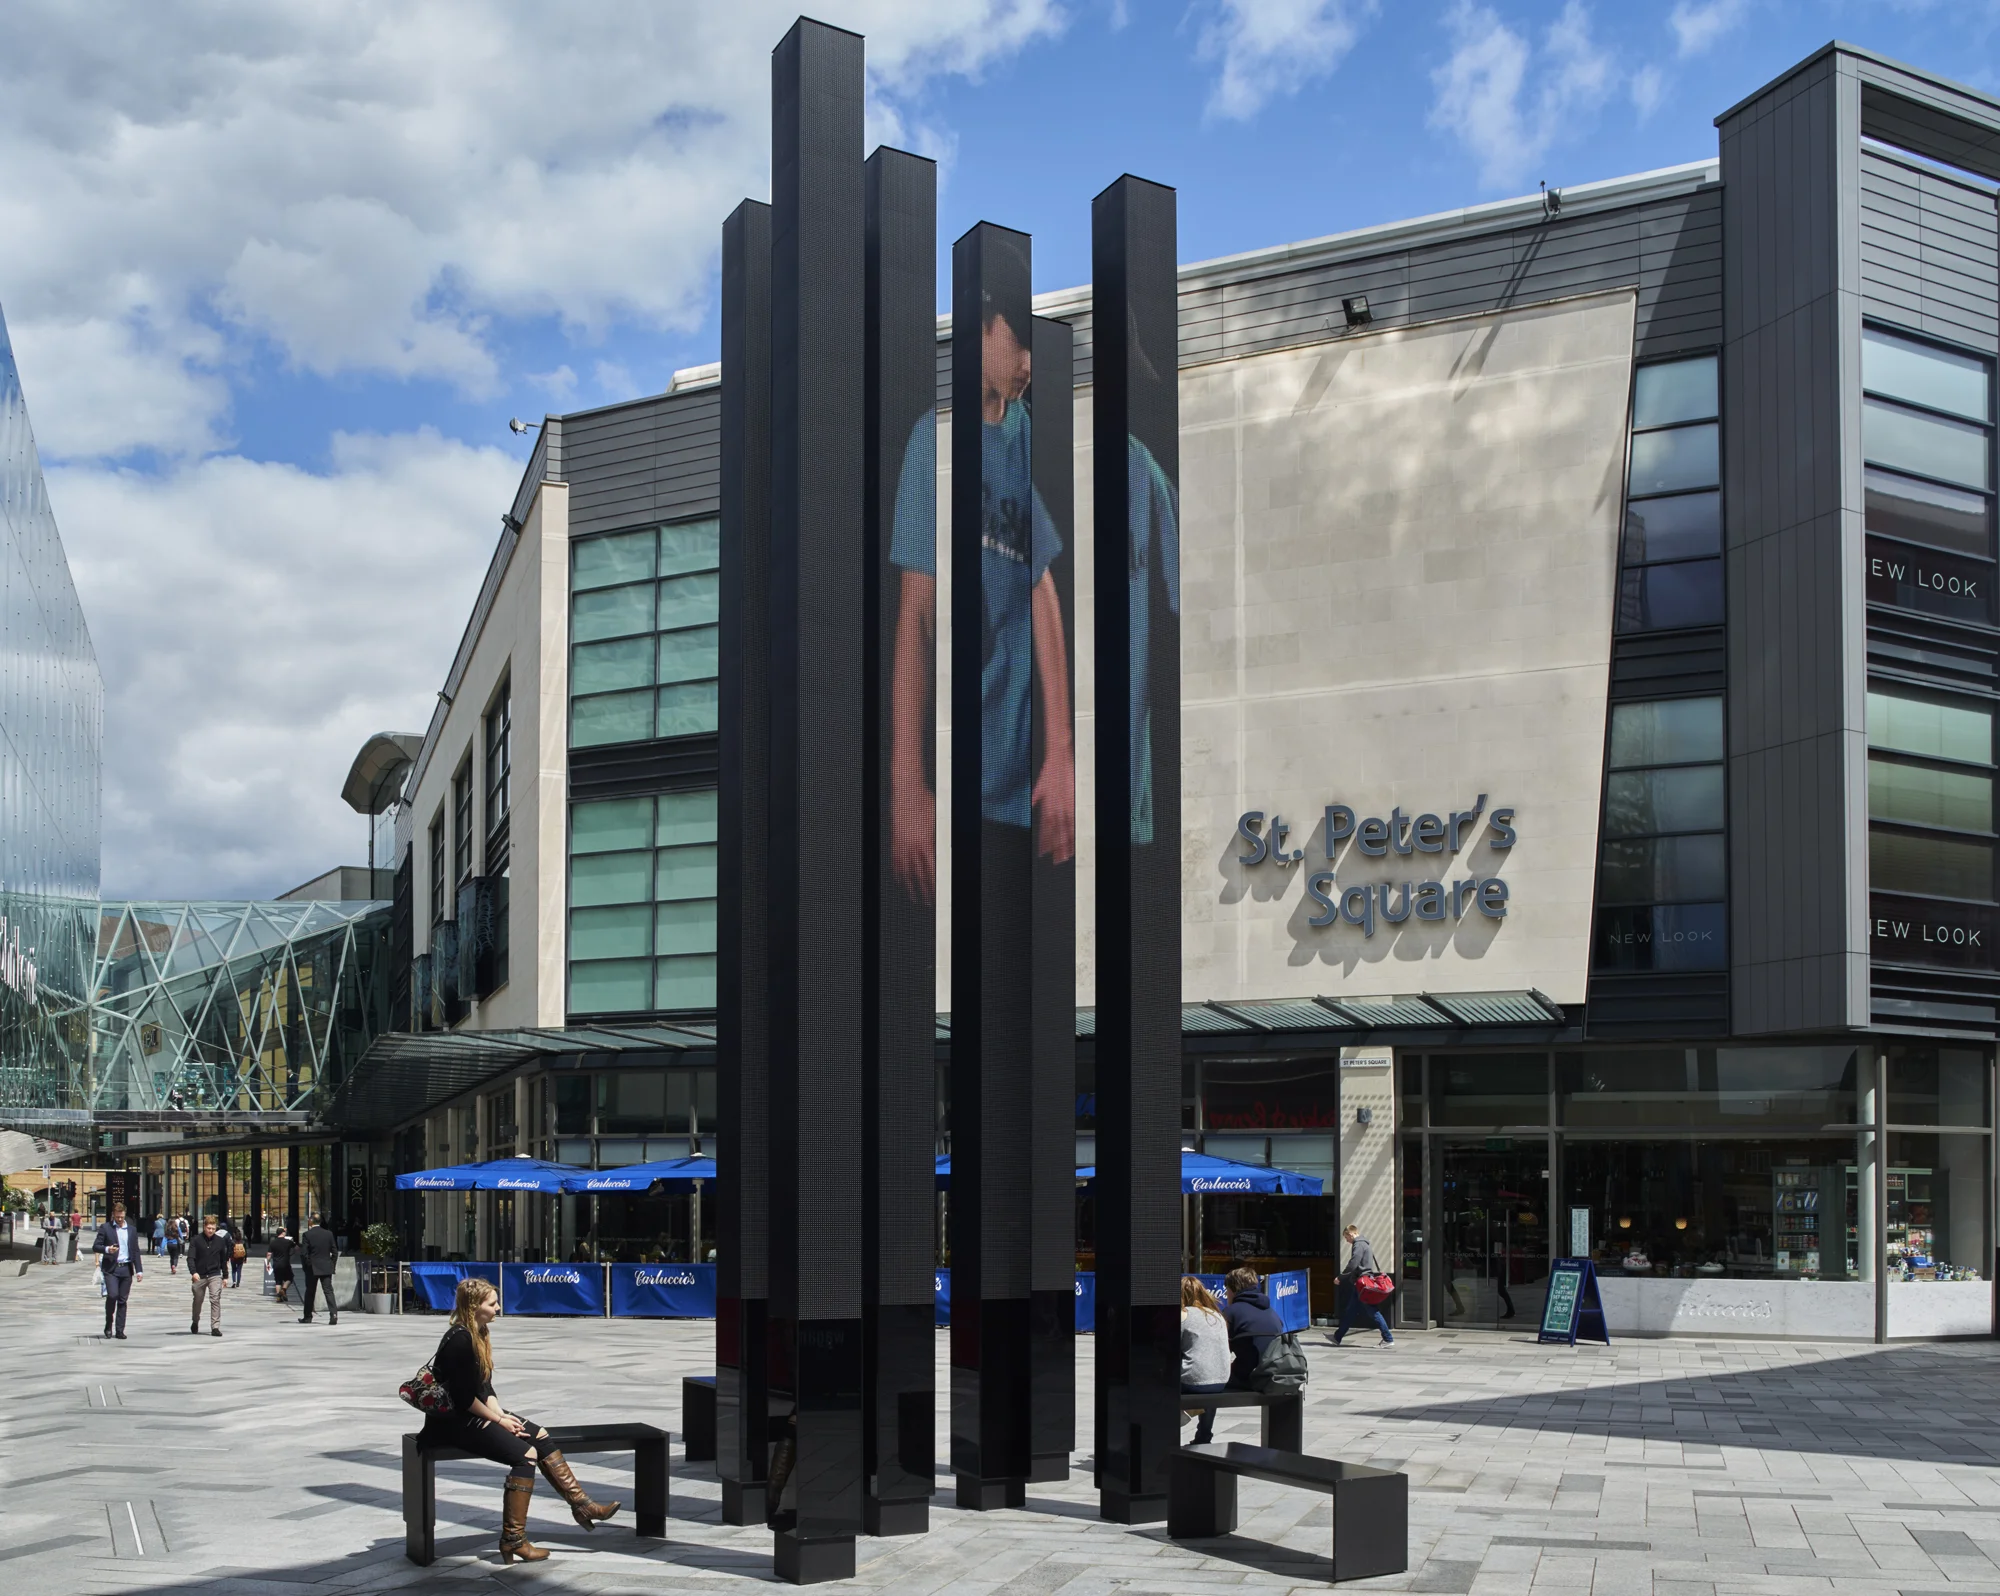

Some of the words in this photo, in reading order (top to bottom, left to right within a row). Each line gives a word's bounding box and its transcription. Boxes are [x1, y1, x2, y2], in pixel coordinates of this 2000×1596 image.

[1865, 557, 1906, 581] EW
[1918, 568, 1977, 599] LOOK
[1237, 810, 1304, 867] St.
[1324, 793, 1518, 860] Peter's
[1306, 871, 1510, 939] Square
[1609, 932, 1652, 944] NEW
[1662, 930, 1713, 943] LOOK
[1868, 918, 1911, 939] EW
[1923, 924, 1981, 947] LOOK
[351, 1167, 363, 1203] next
[414, 1176, 455, 1188] Carluccio's
[497, 1176, 540, 1189] Carluccio's
[587, 1178, 631, 1189] Carluccio's
[1191, 1176, 1251, 1192] Carluccio's
[523, 1268, 580, 1285] Carluccio's
[634, 1269, 696, 1287] Carluccio's
